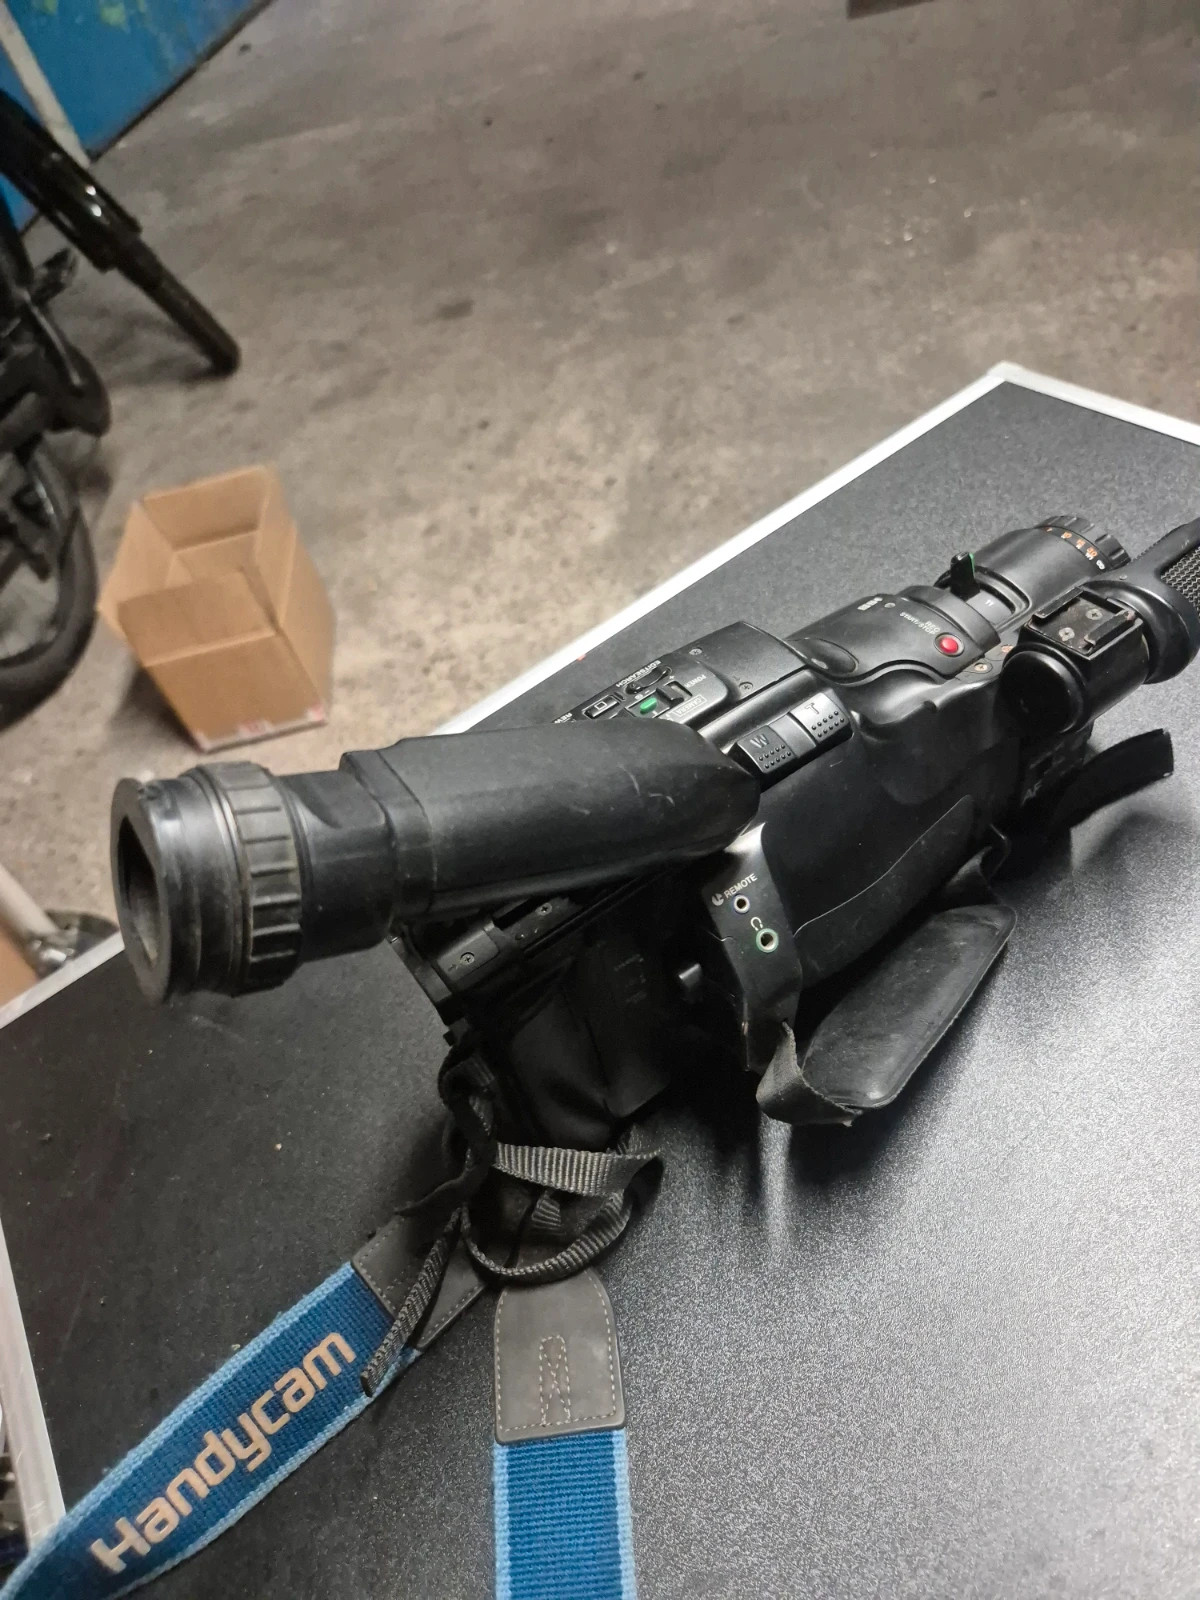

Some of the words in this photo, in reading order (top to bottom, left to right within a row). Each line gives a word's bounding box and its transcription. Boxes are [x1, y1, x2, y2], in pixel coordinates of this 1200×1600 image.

[804, 702, 820, 715] T
[749, 733, 770, 749] W
[723, 872, 759, 900] REMOTE
[91, 1332, 356, 1574] Handycam
